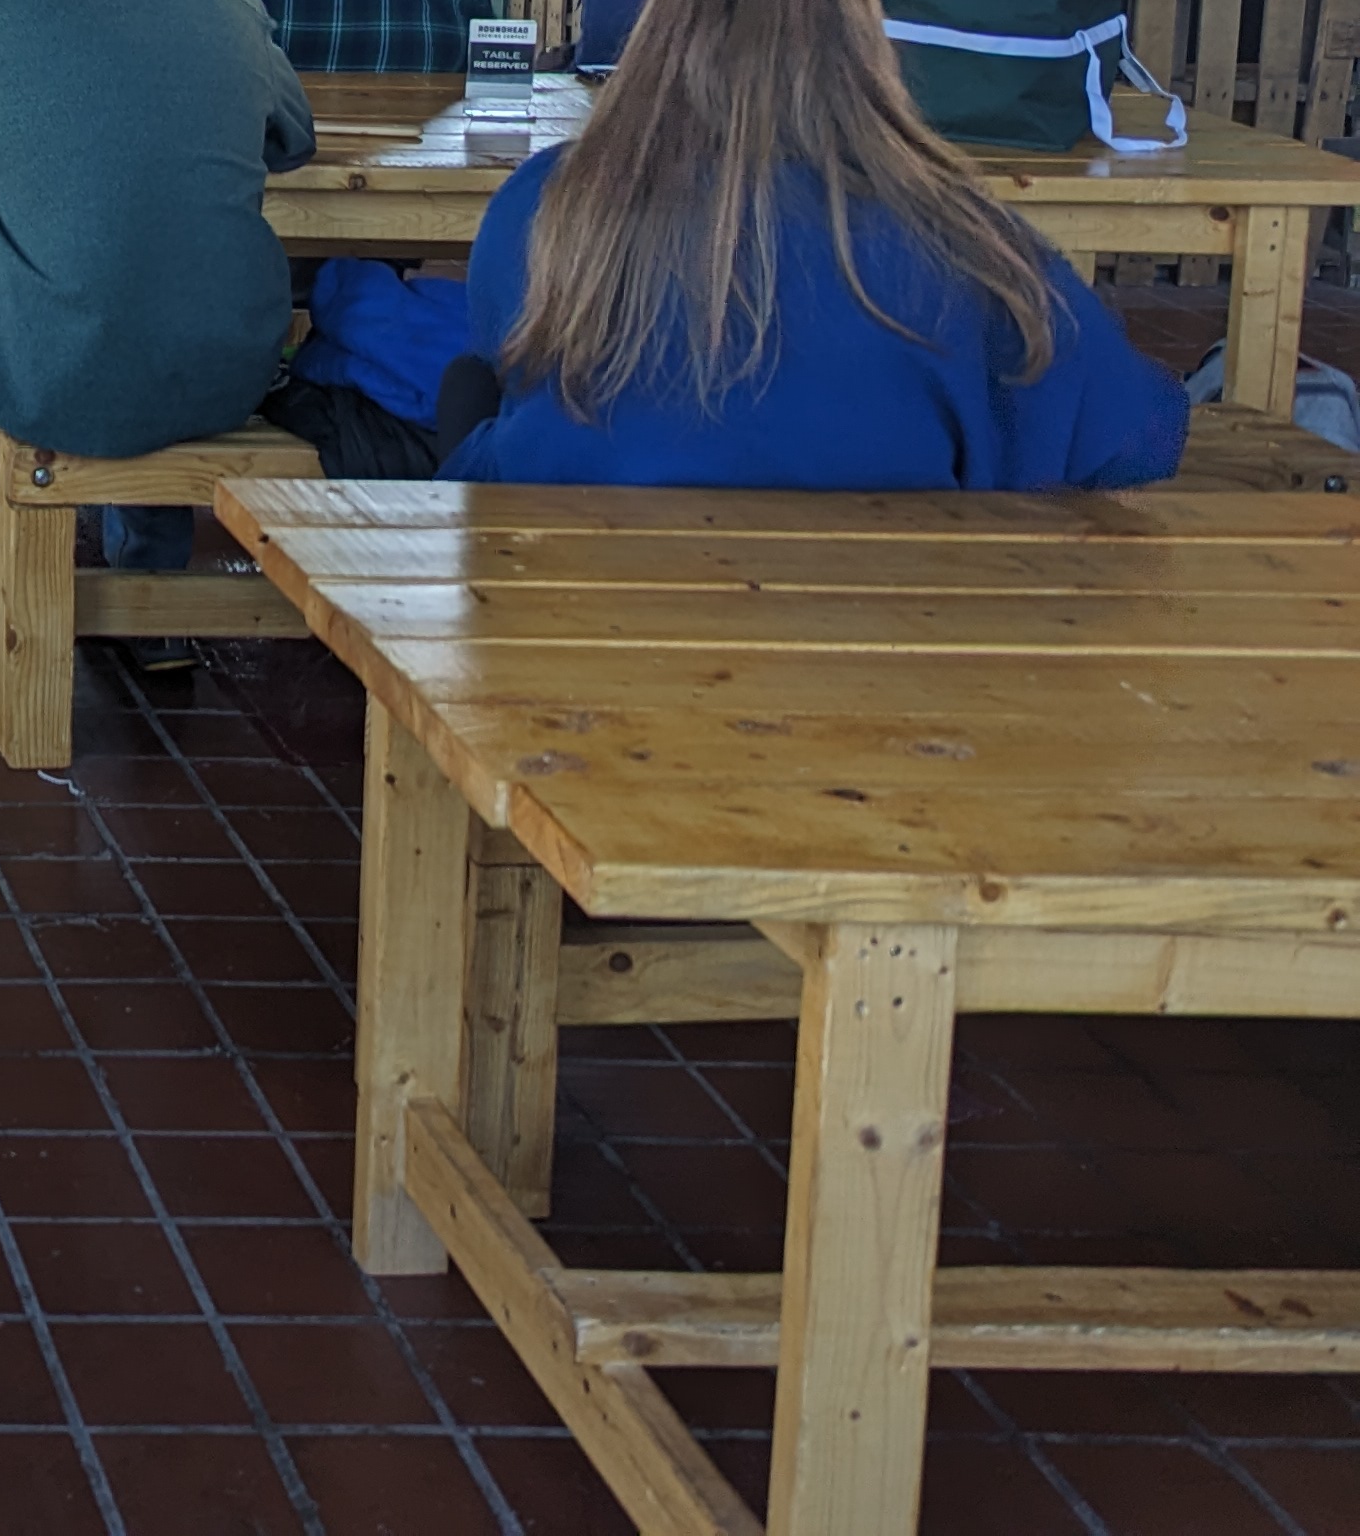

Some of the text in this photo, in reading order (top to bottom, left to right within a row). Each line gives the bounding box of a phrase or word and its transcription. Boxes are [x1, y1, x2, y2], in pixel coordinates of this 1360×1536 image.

[479, 25, 528, 34] ROUNDHEAD
[482, 50, 520, 60] TABLE
[473, 61, 529, 70] RESERVED
